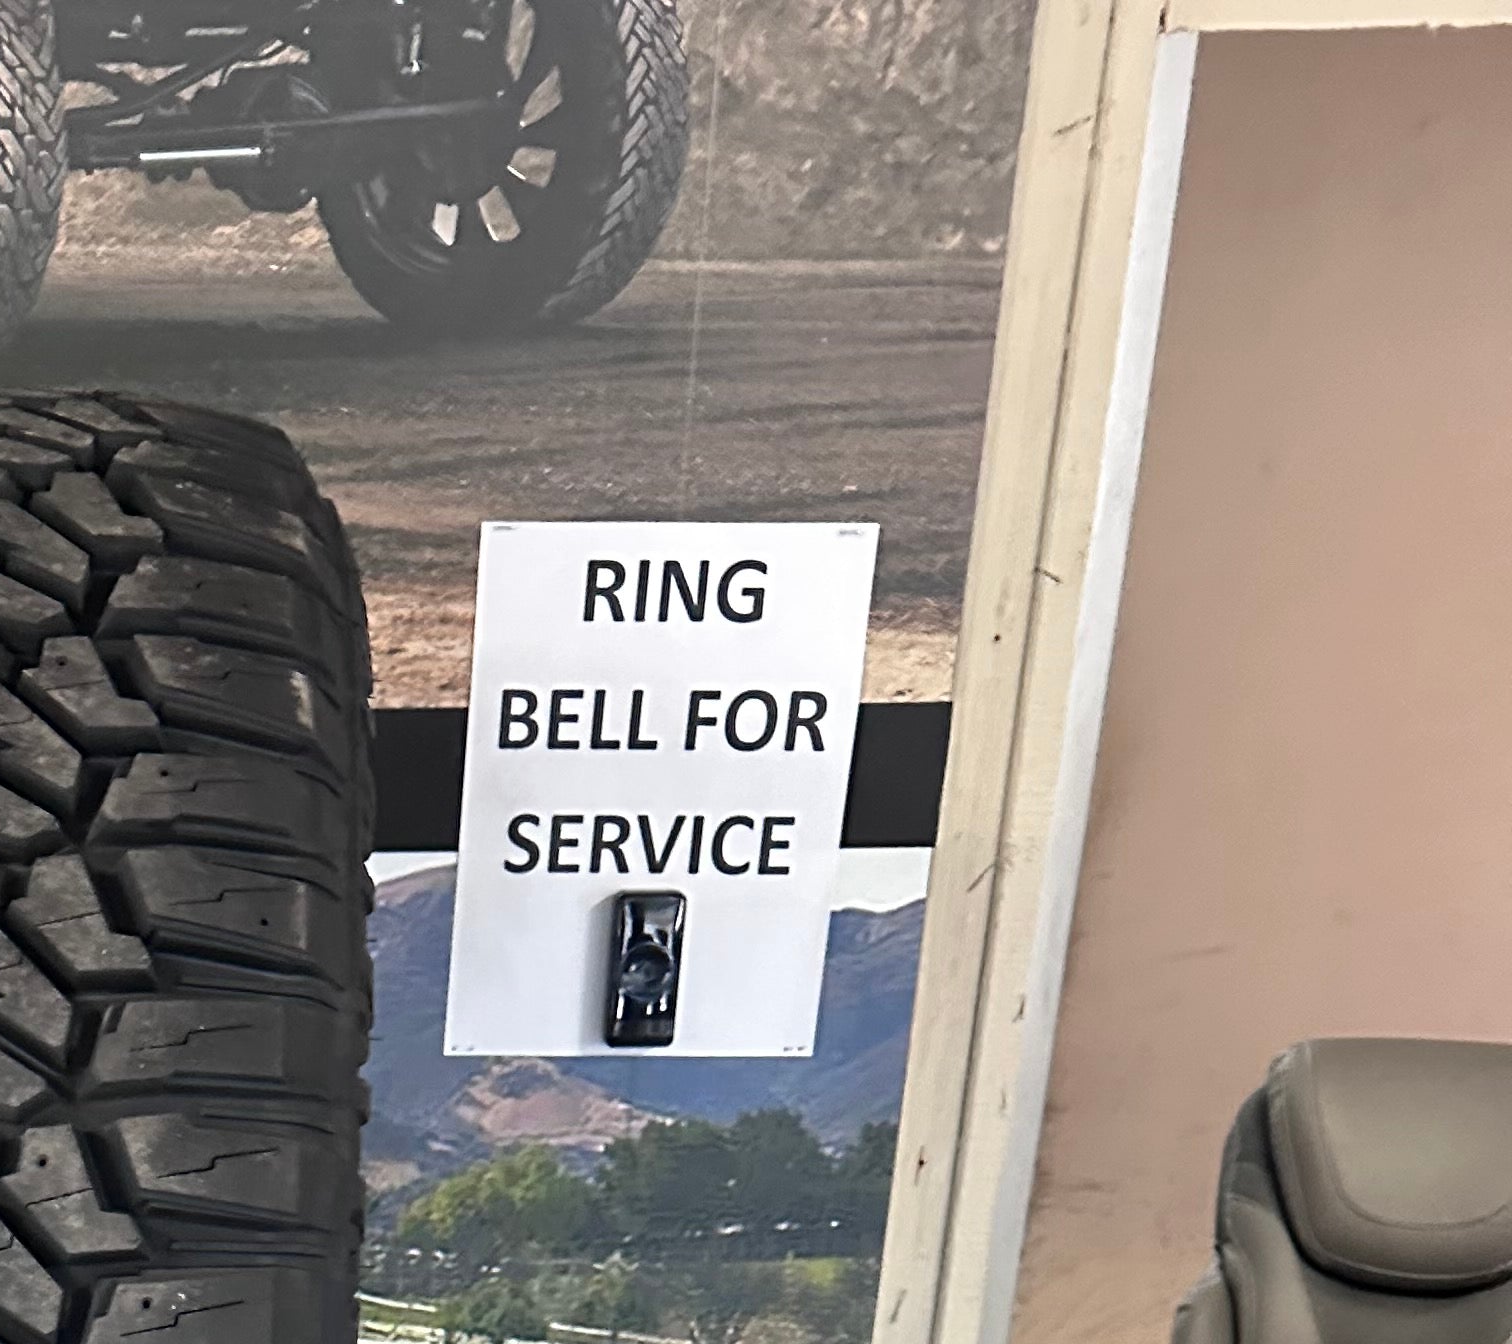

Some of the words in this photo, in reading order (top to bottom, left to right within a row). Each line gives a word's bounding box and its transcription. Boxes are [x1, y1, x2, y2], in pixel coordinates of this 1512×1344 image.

[583, 558, 769, 624] RING
[498, 688, 658, 751] BELL
[685, 689, 829, 752] FOR
[503, 813, 796, 876] SERVICE
